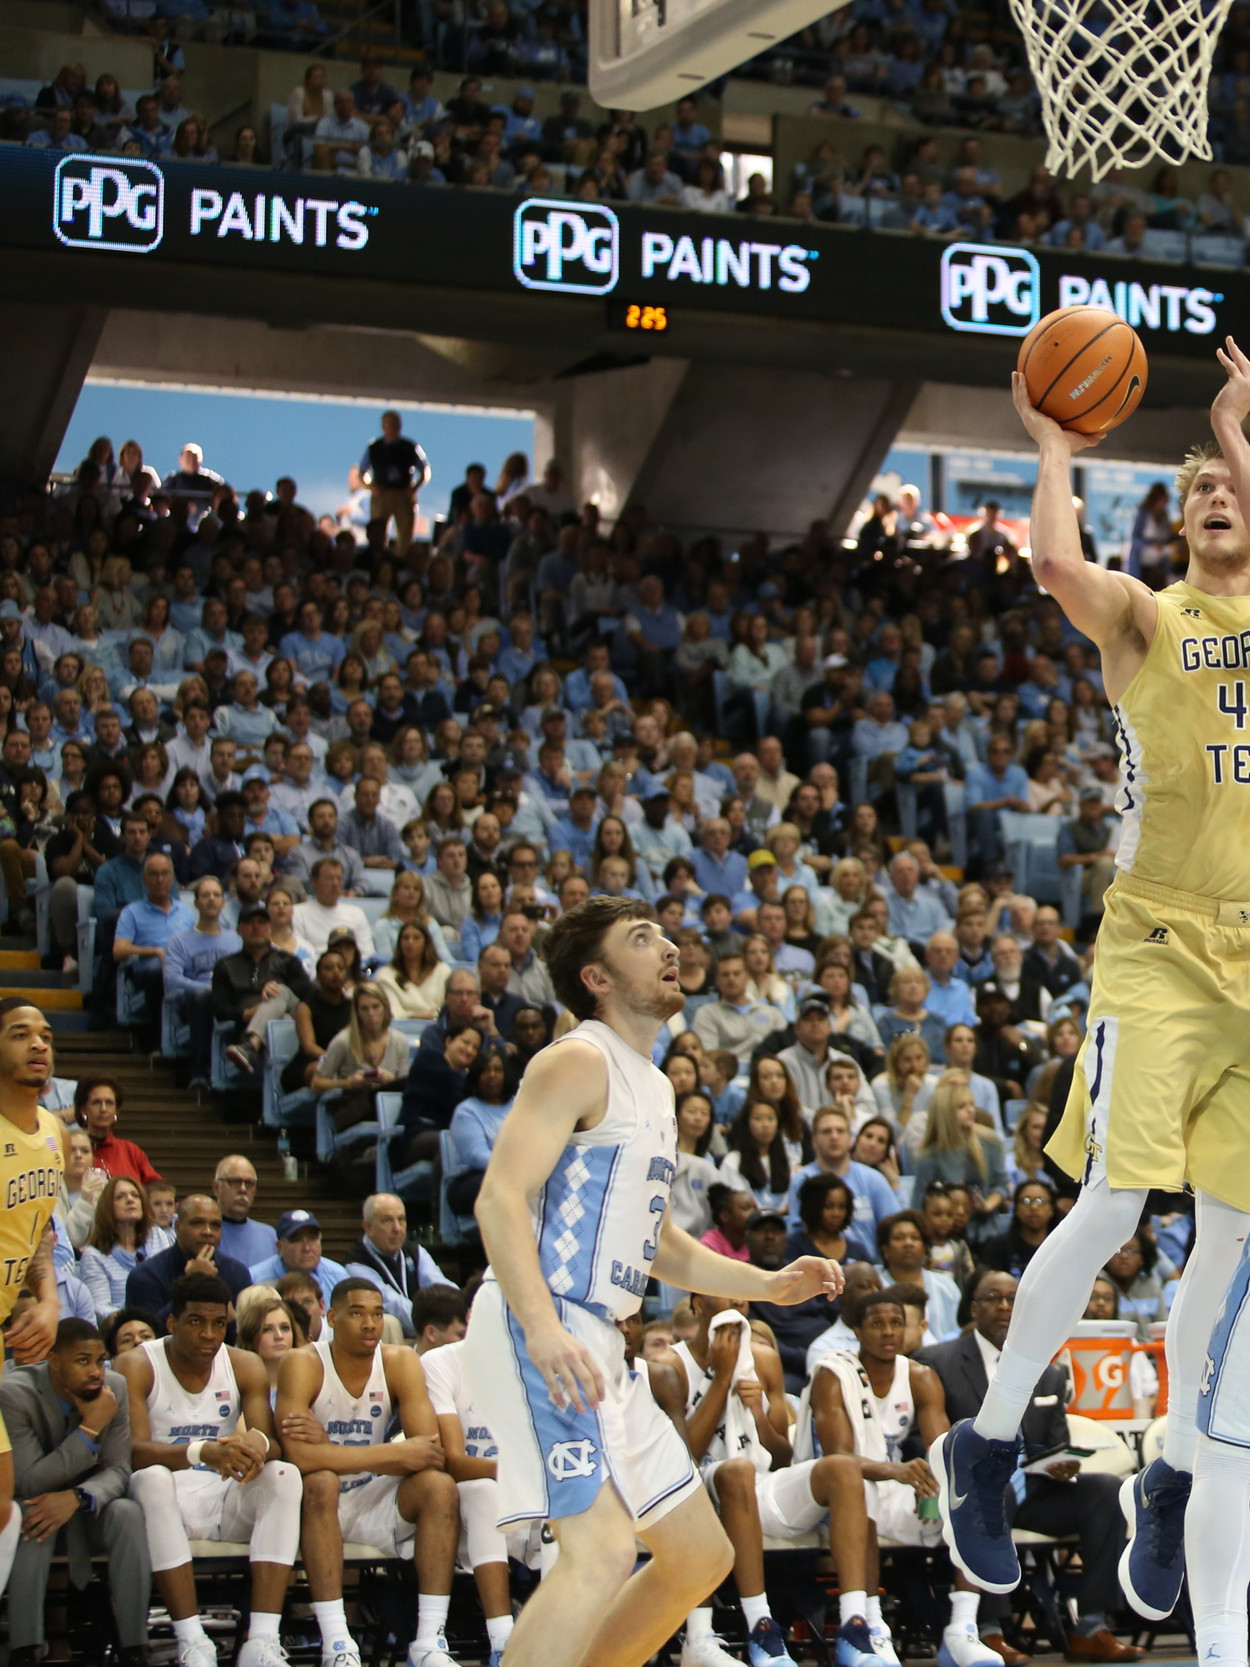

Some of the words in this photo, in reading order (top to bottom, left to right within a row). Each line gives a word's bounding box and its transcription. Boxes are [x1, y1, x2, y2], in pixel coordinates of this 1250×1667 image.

[62, 167, 157, 238] PPG
[190, 188, 369, 250] PAINTS
[522, 211, 613, 280] PPG
[641, 231, 811, 292] PAINTS
[950, 254, 1031, 323] PPG
[1059, 274, 1217, 334] PAINTS
[643, 1195, 667, 1261] 3
[5, 1256, 29, 1286] TE
[1098, 1354, 1123, 1388] G
[168, 1423, 220, 1438] NORTH
